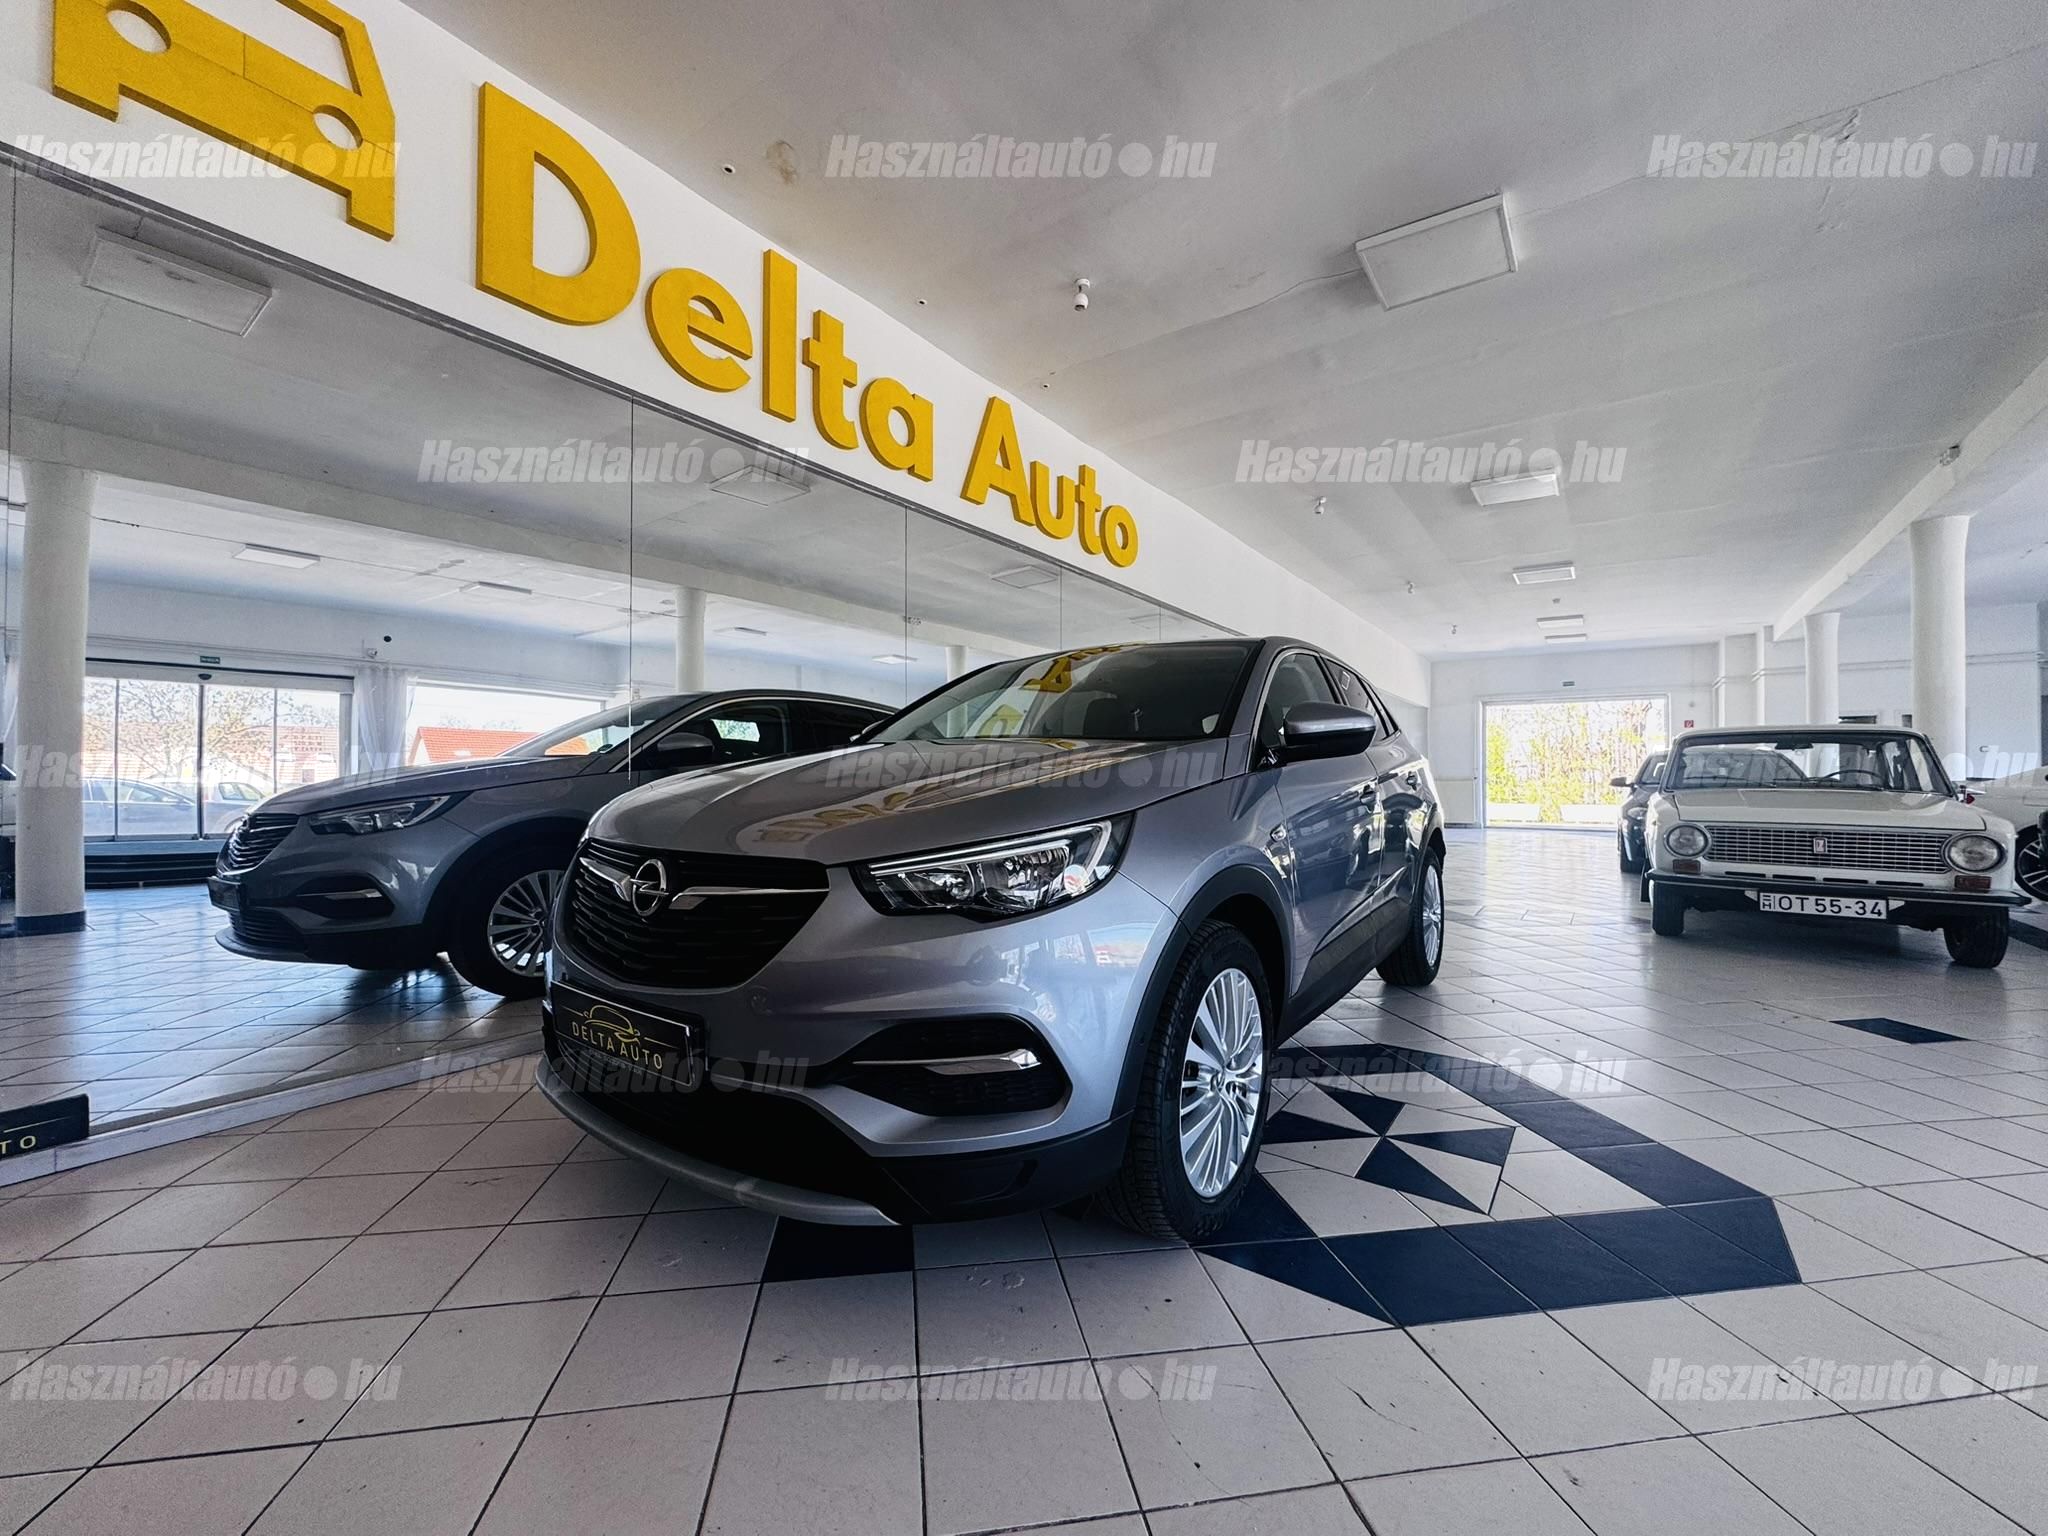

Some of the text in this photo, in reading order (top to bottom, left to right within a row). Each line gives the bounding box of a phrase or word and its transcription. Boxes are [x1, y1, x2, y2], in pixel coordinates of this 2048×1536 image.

[475, 81, 1139, 568] Delta Auto
[571, 1021, 615, 1052] DELTA
[619, 1043, 663, 1070] AUTO
